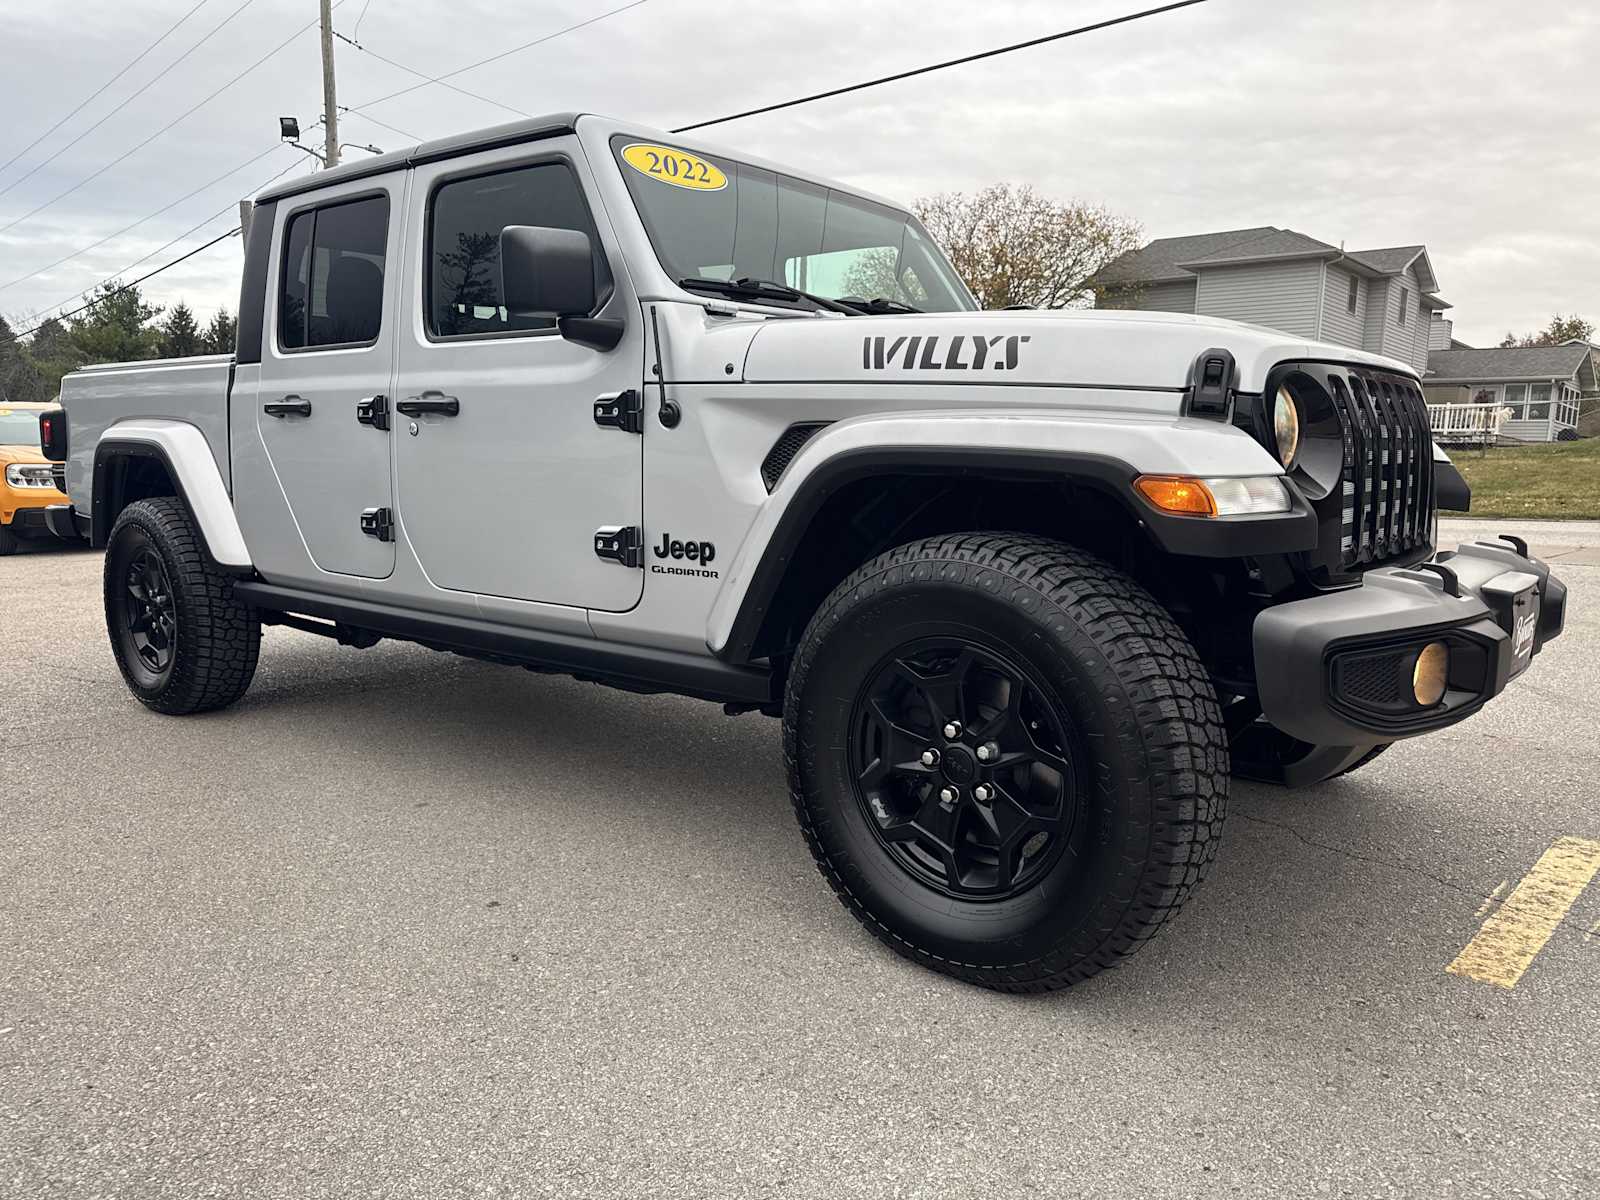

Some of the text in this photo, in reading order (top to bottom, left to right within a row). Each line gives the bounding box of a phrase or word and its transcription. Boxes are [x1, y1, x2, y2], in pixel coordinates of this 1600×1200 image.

[645, 151, 711, 183] 2022
[863, 335, 1031, 370] WILLYS
[653, 532, 716, 567] Jeep
[651, 565, 719, 579] GLADIATOR
